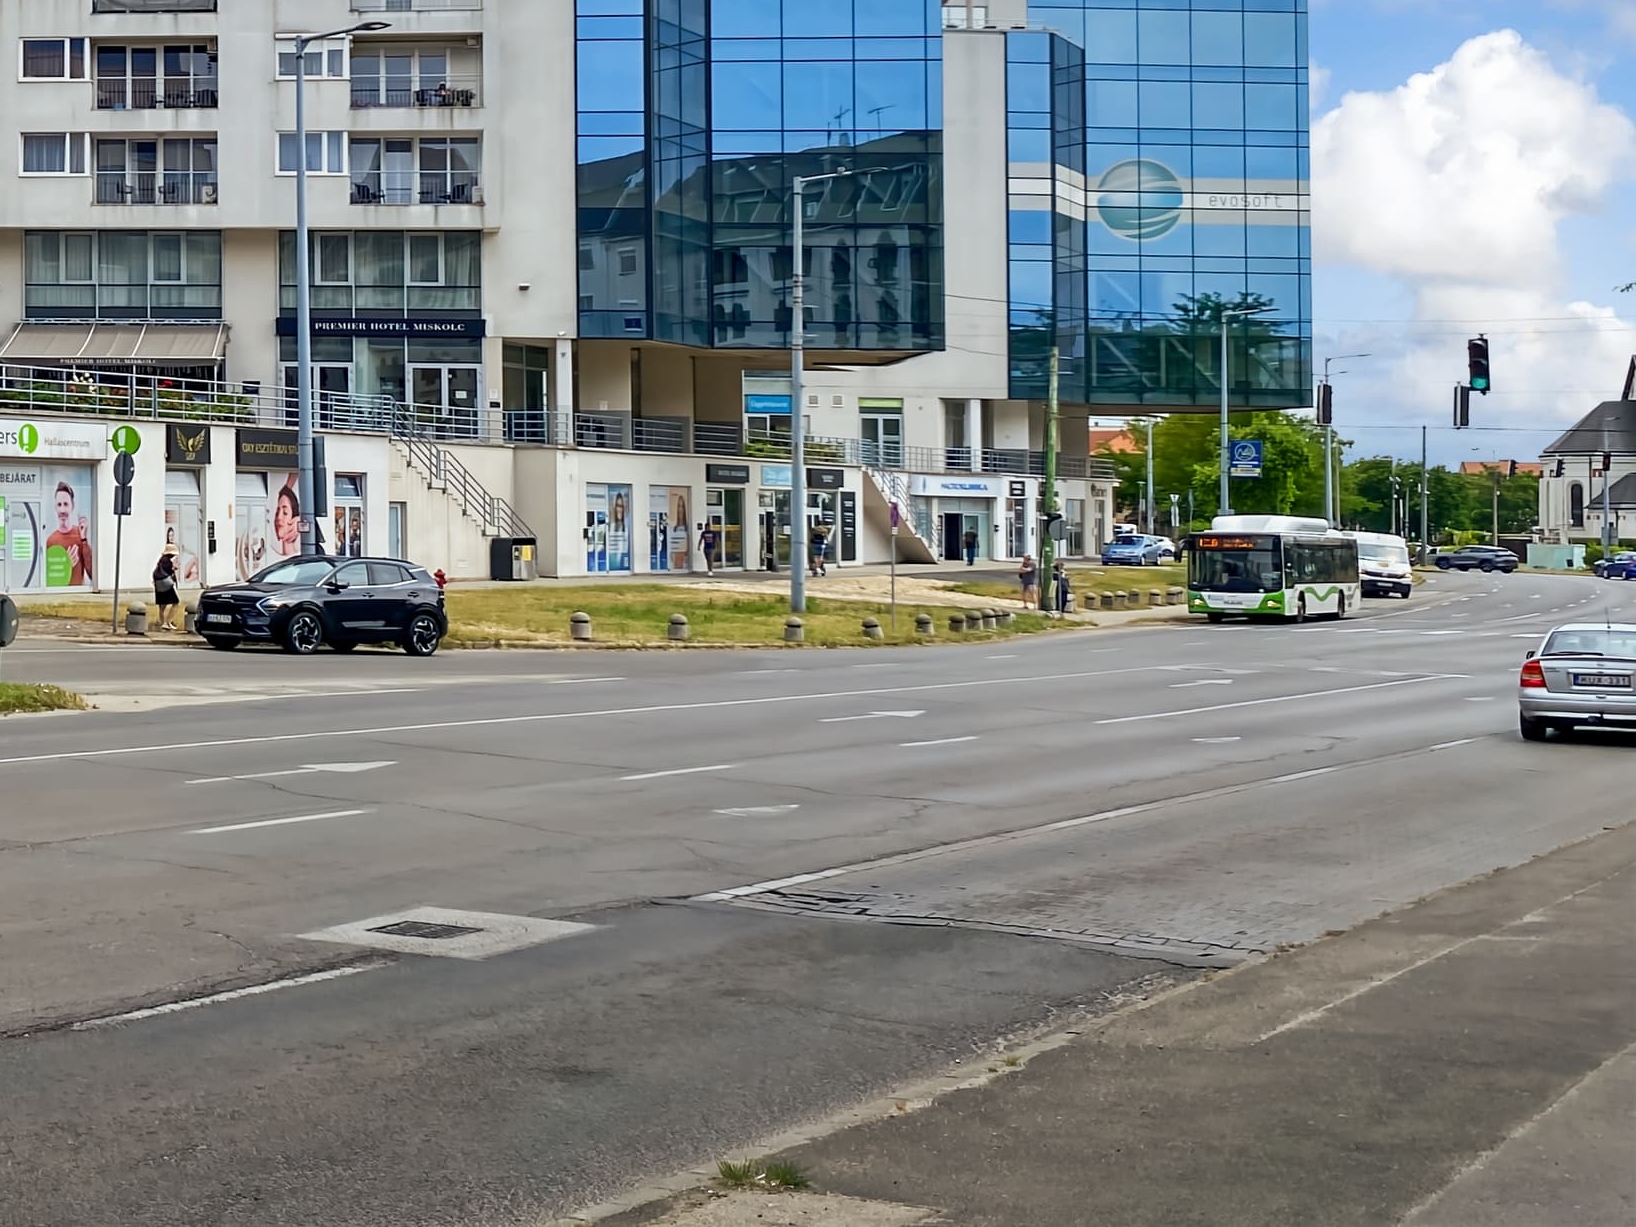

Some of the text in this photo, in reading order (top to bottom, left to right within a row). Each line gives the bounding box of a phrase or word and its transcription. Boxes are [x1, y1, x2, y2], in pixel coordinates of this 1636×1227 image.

[315, 321, 466, 332] PREMIER HOTEL MISKOLC
[0, 472, 37, 484] BEJÁRAT
